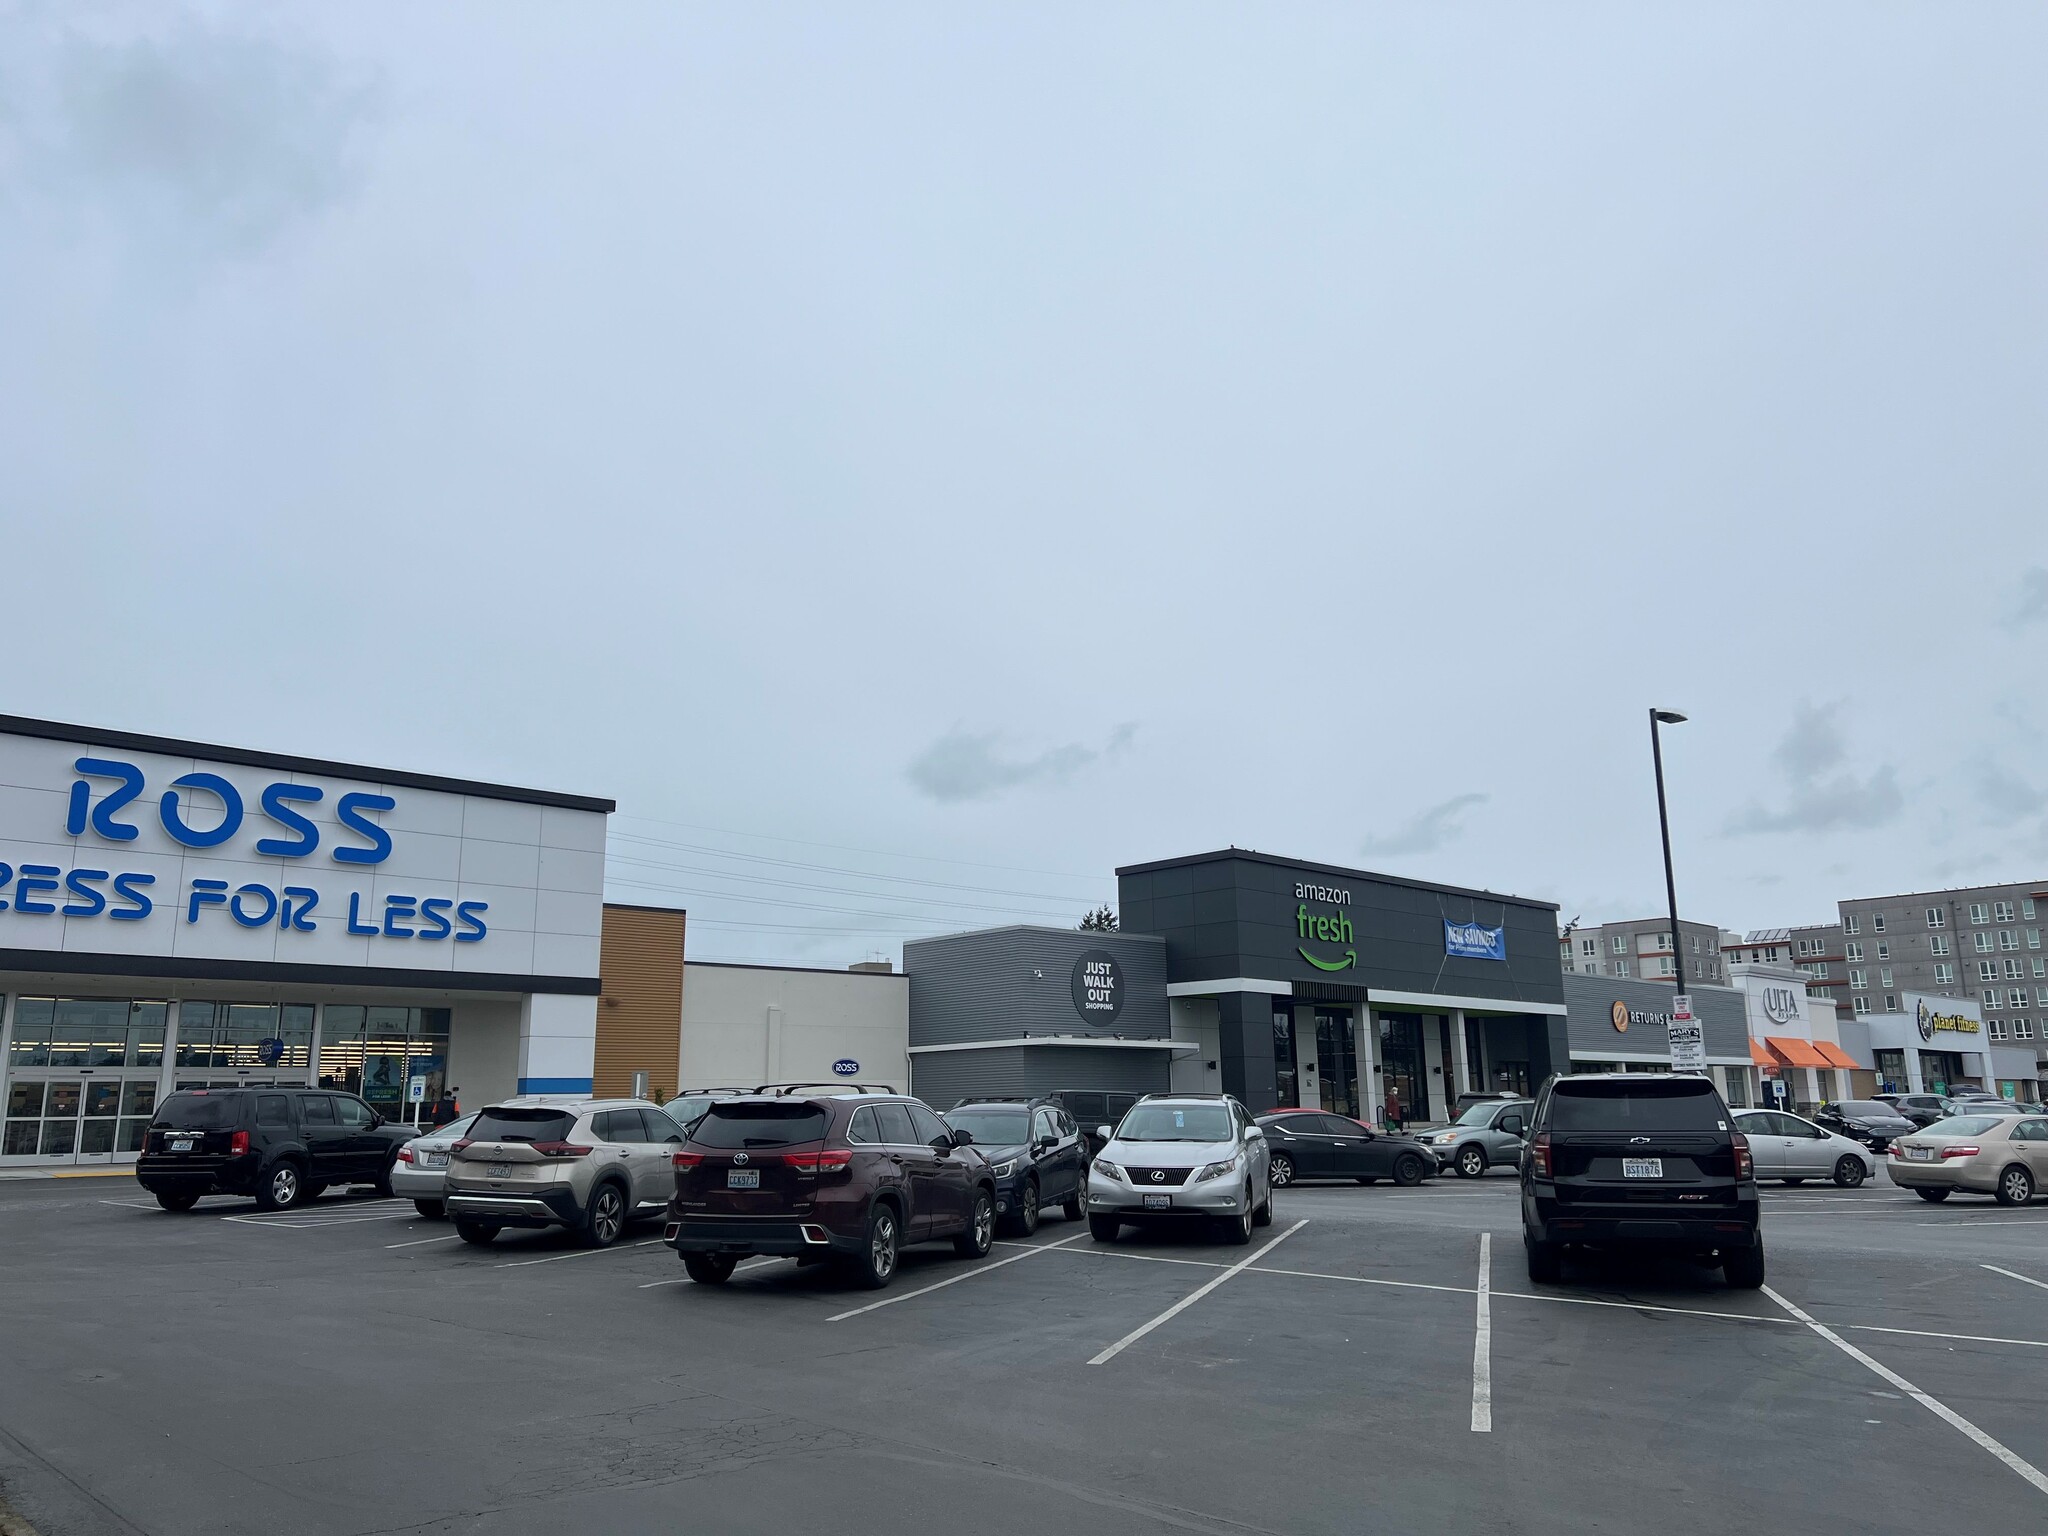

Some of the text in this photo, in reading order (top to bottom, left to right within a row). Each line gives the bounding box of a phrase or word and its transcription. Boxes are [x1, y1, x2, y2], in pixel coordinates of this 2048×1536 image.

[66, 757, 396, 865] ROSS
[1295, 882, 1351, 905] amazon
[187, 879, 319, 933] FOR
[346, 891, 489, 942] LESS
[1296, 904, 1353, 943] fresh
[1447, 926, 1464, 944] NEW
[1085, 961, 1111, 975] JUST
[1083, 975, 1114, 988] WALK
[1087, 988, 1110, 1002] OUT
[1766, 988, 1798, 1013] ULTA
[1085, 1002, 1114, 1010] SHOPPING
[1630, 1011, 1664, 1025] RETURNS
[1933, 1012, 1980, 1033] planet fitness
[1670, 1028, 1699, 1037] MARY'S
[835, 1063, 857, 1072] ROSS
[1626, 1165, 1660, 1174] BST1876
[729, 1175, 758, 1185] CCK9733
